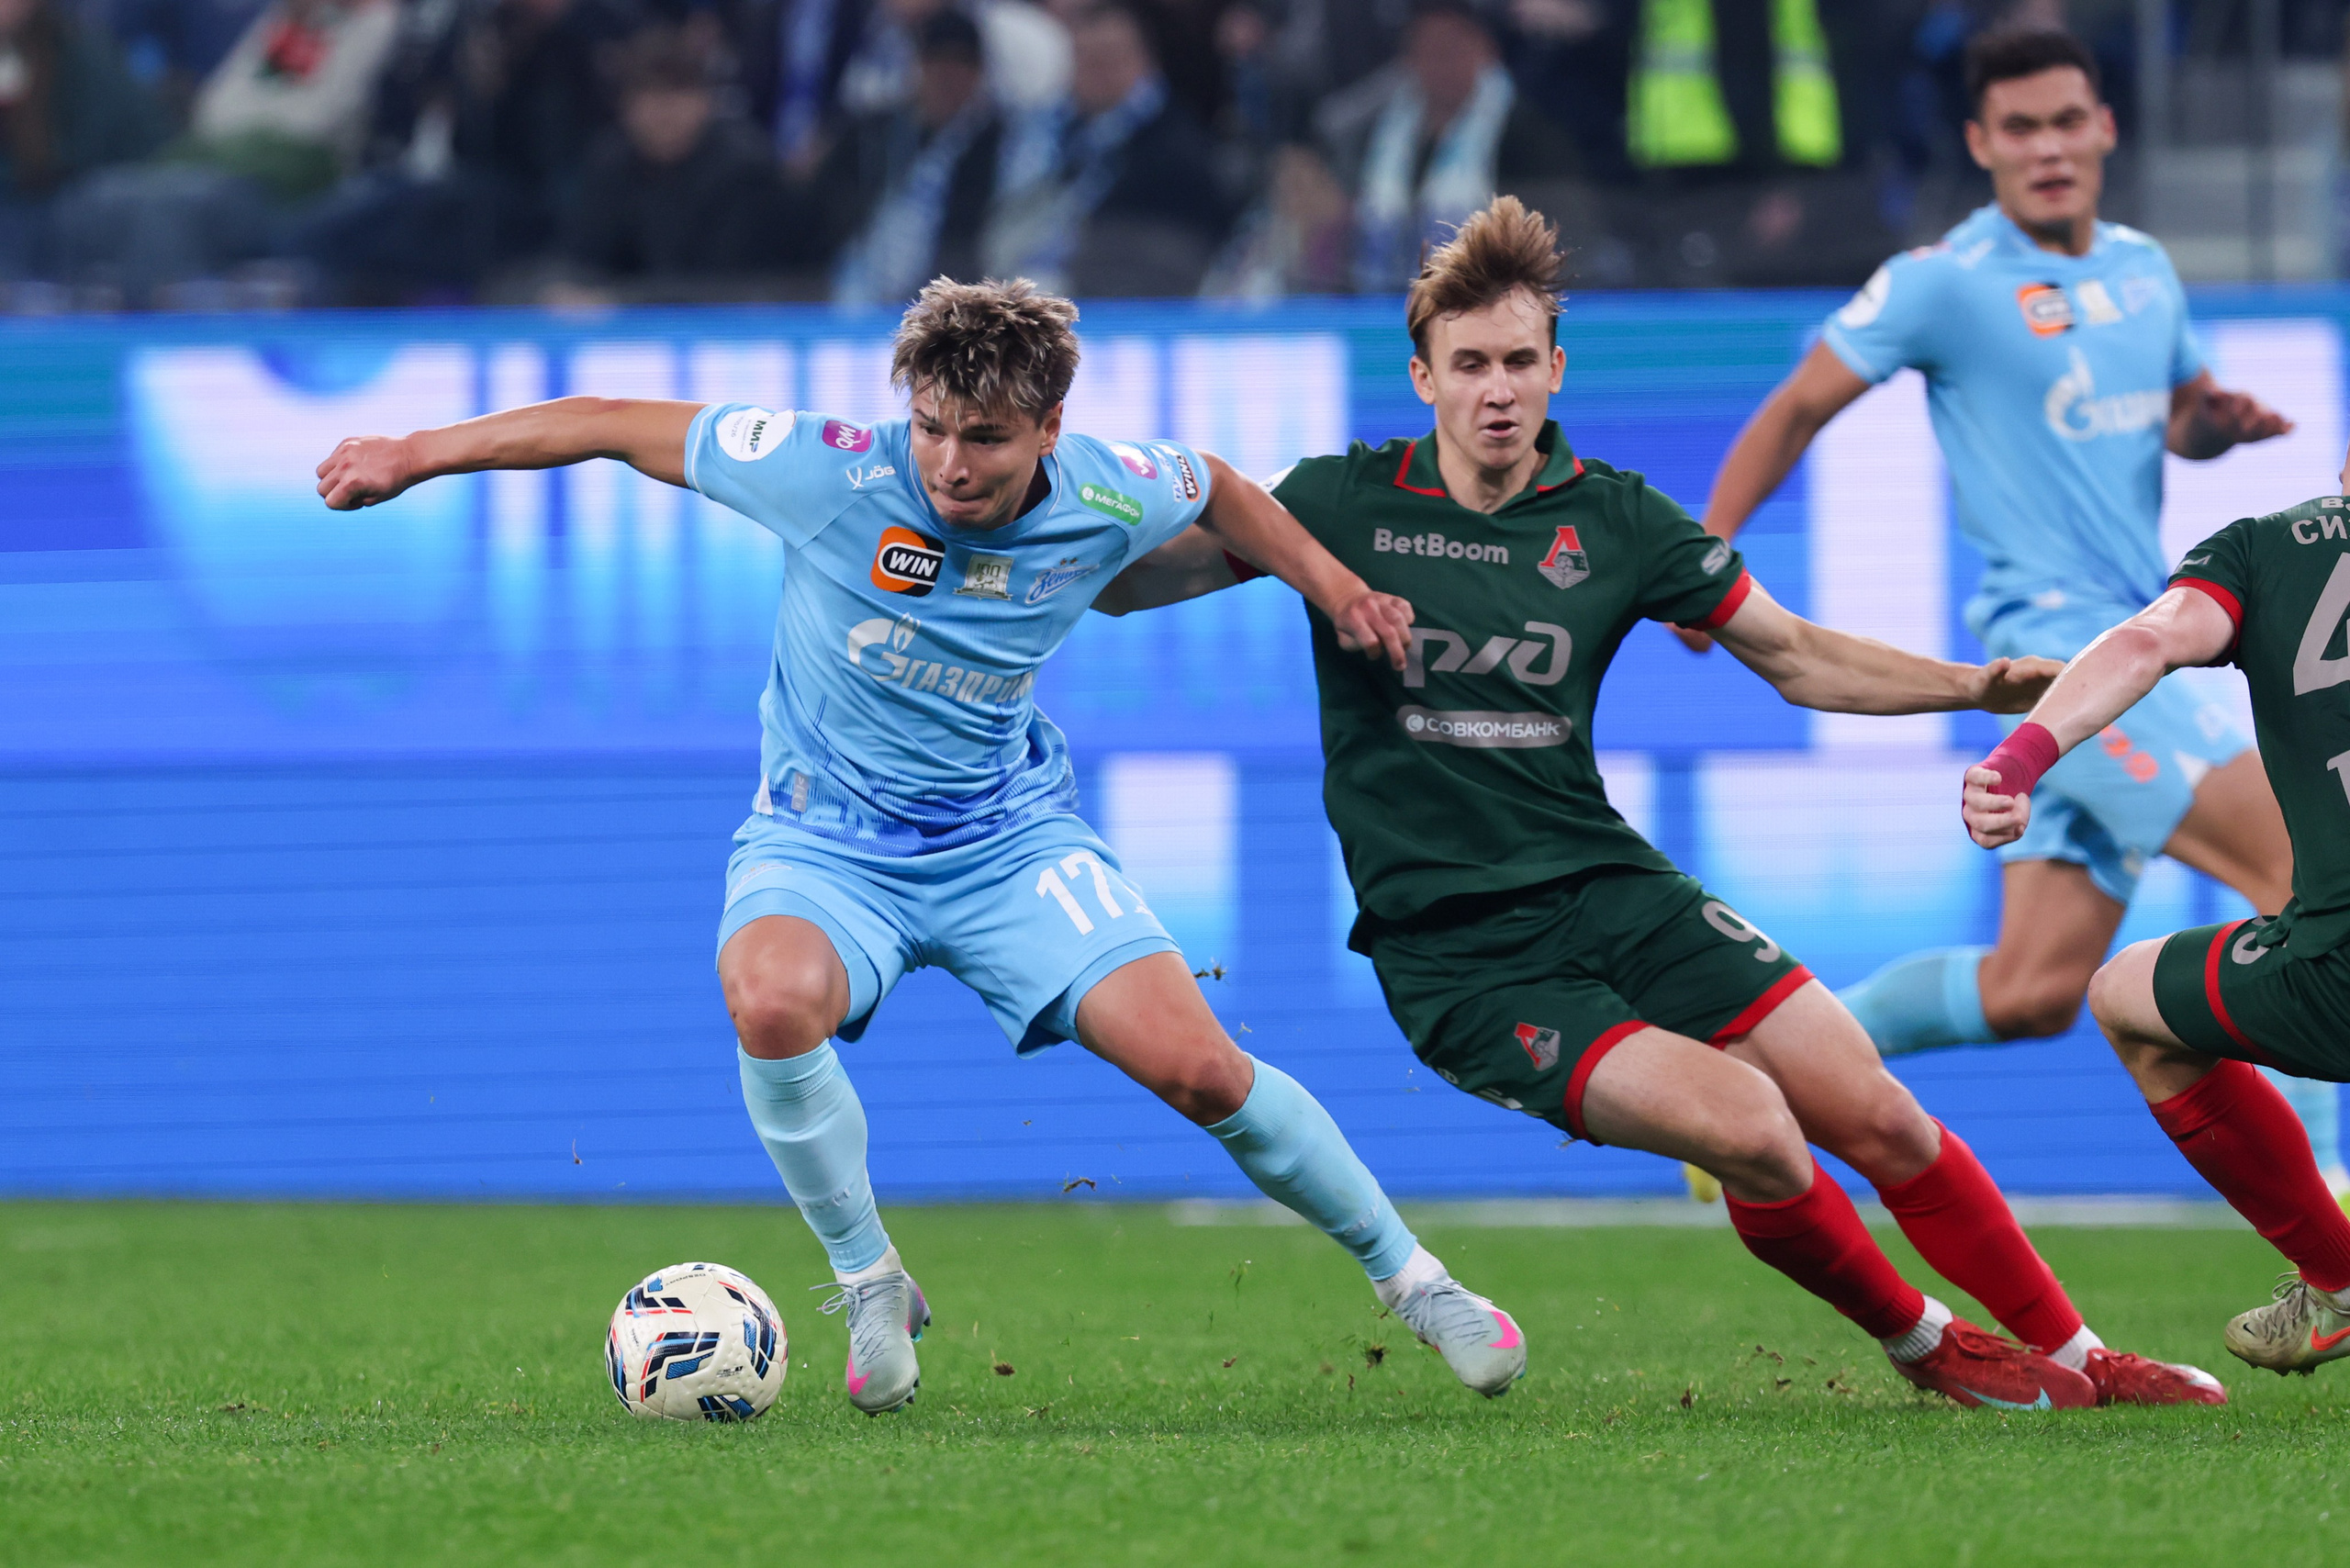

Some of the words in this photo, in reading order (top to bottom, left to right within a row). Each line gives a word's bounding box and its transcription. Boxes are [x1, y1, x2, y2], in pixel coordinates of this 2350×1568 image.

[749, 420, 767, 453] МИР
[865, 465, 896, 480] JÖG
[1181, 454, 1197, 495] WINL
[1094, 493, 1140, 518] МЕГАФОН
[2291, 515, 2350, 545] СИ
[1373, 528, 1509, 565] BetBoom
[889, 551, 938, 577] WIN
[1426, 717, 1561, 738] СОВКОМБАНК
[1035, 852, 1125, 935] 17
[1702, 901, 1781, 963] 9
